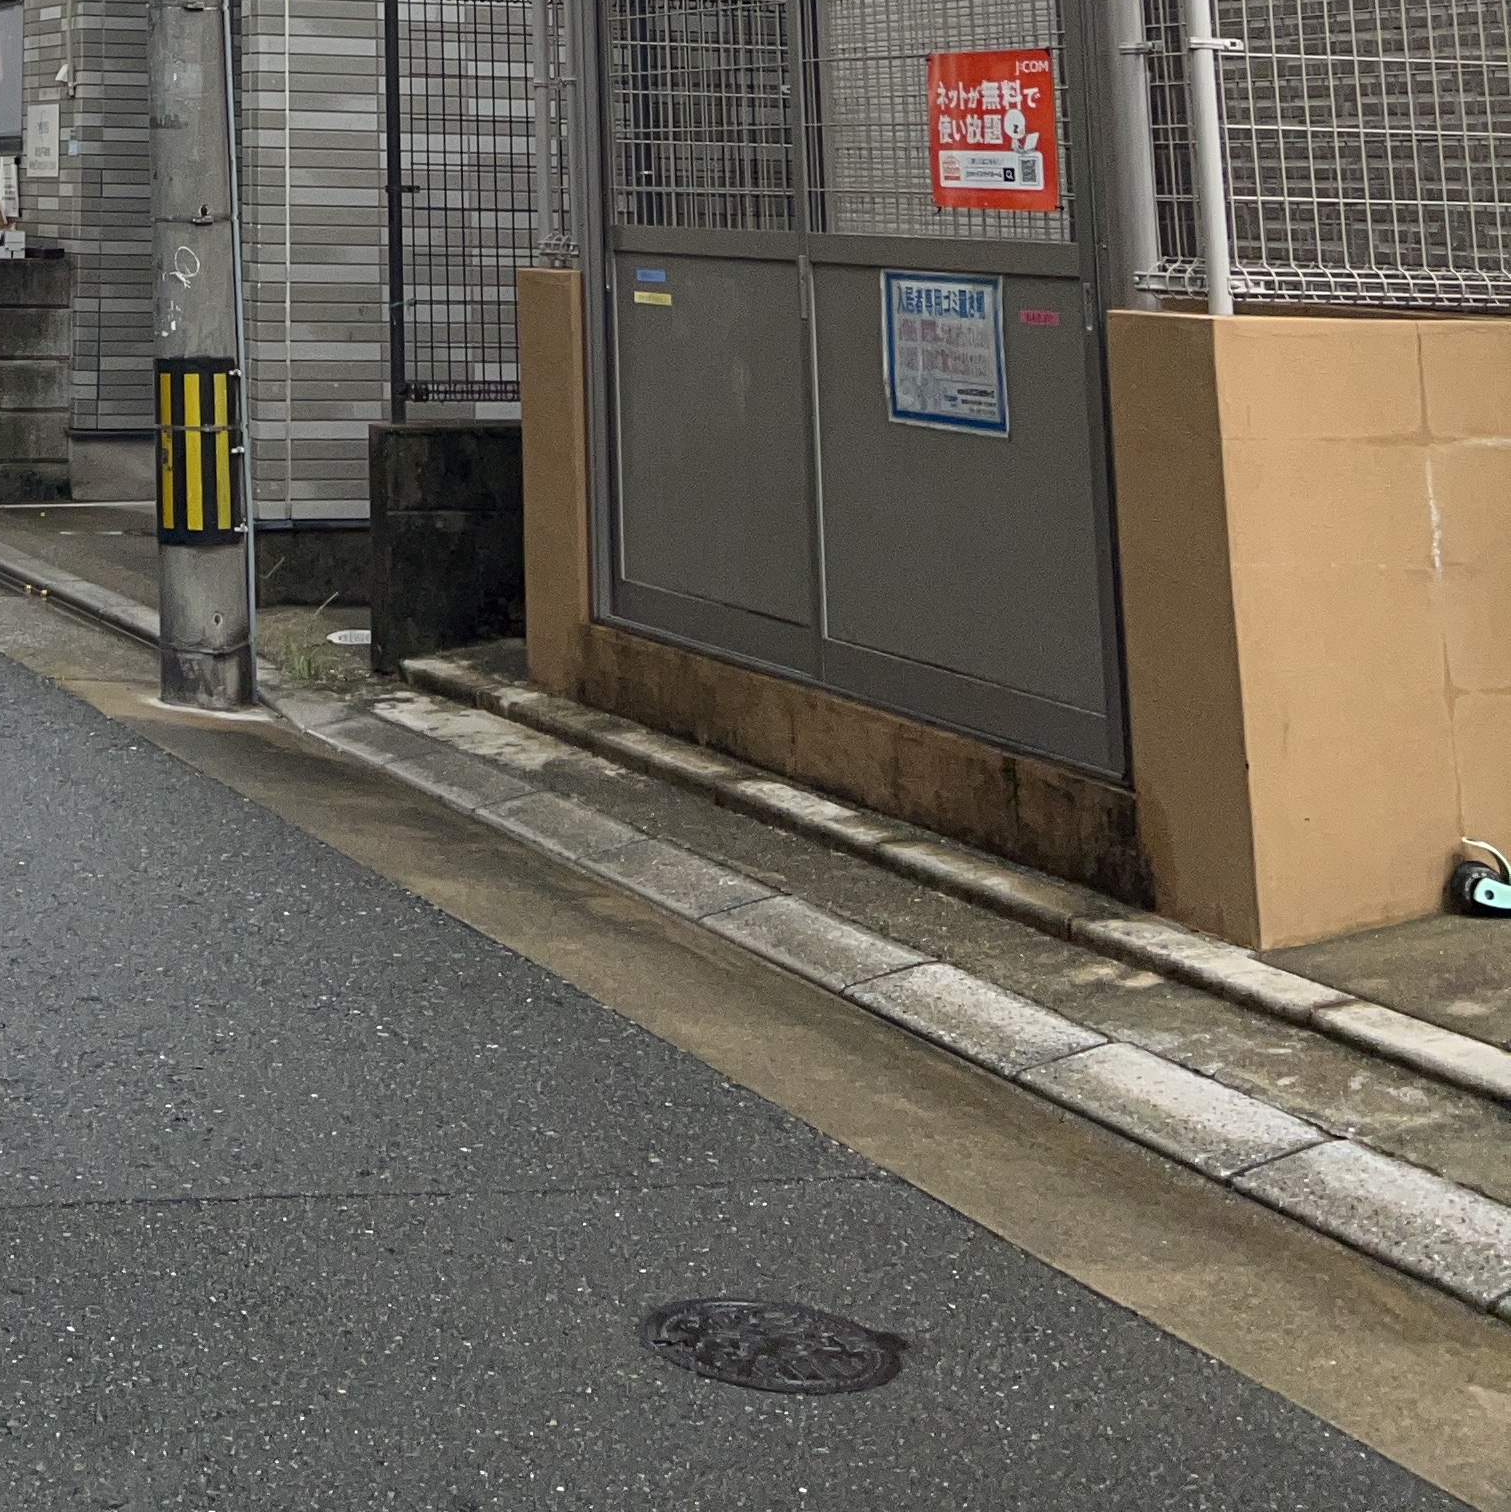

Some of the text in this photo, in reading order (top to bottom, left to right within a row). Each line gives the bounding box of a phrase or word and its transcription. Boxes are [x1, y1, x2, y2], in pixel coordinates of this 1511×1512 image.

[1015, 60, 1049, 76] J:COM
[937, 79, 1041, 110] ネットが無料で
[938, 114, 1003, 144] 使い放題
